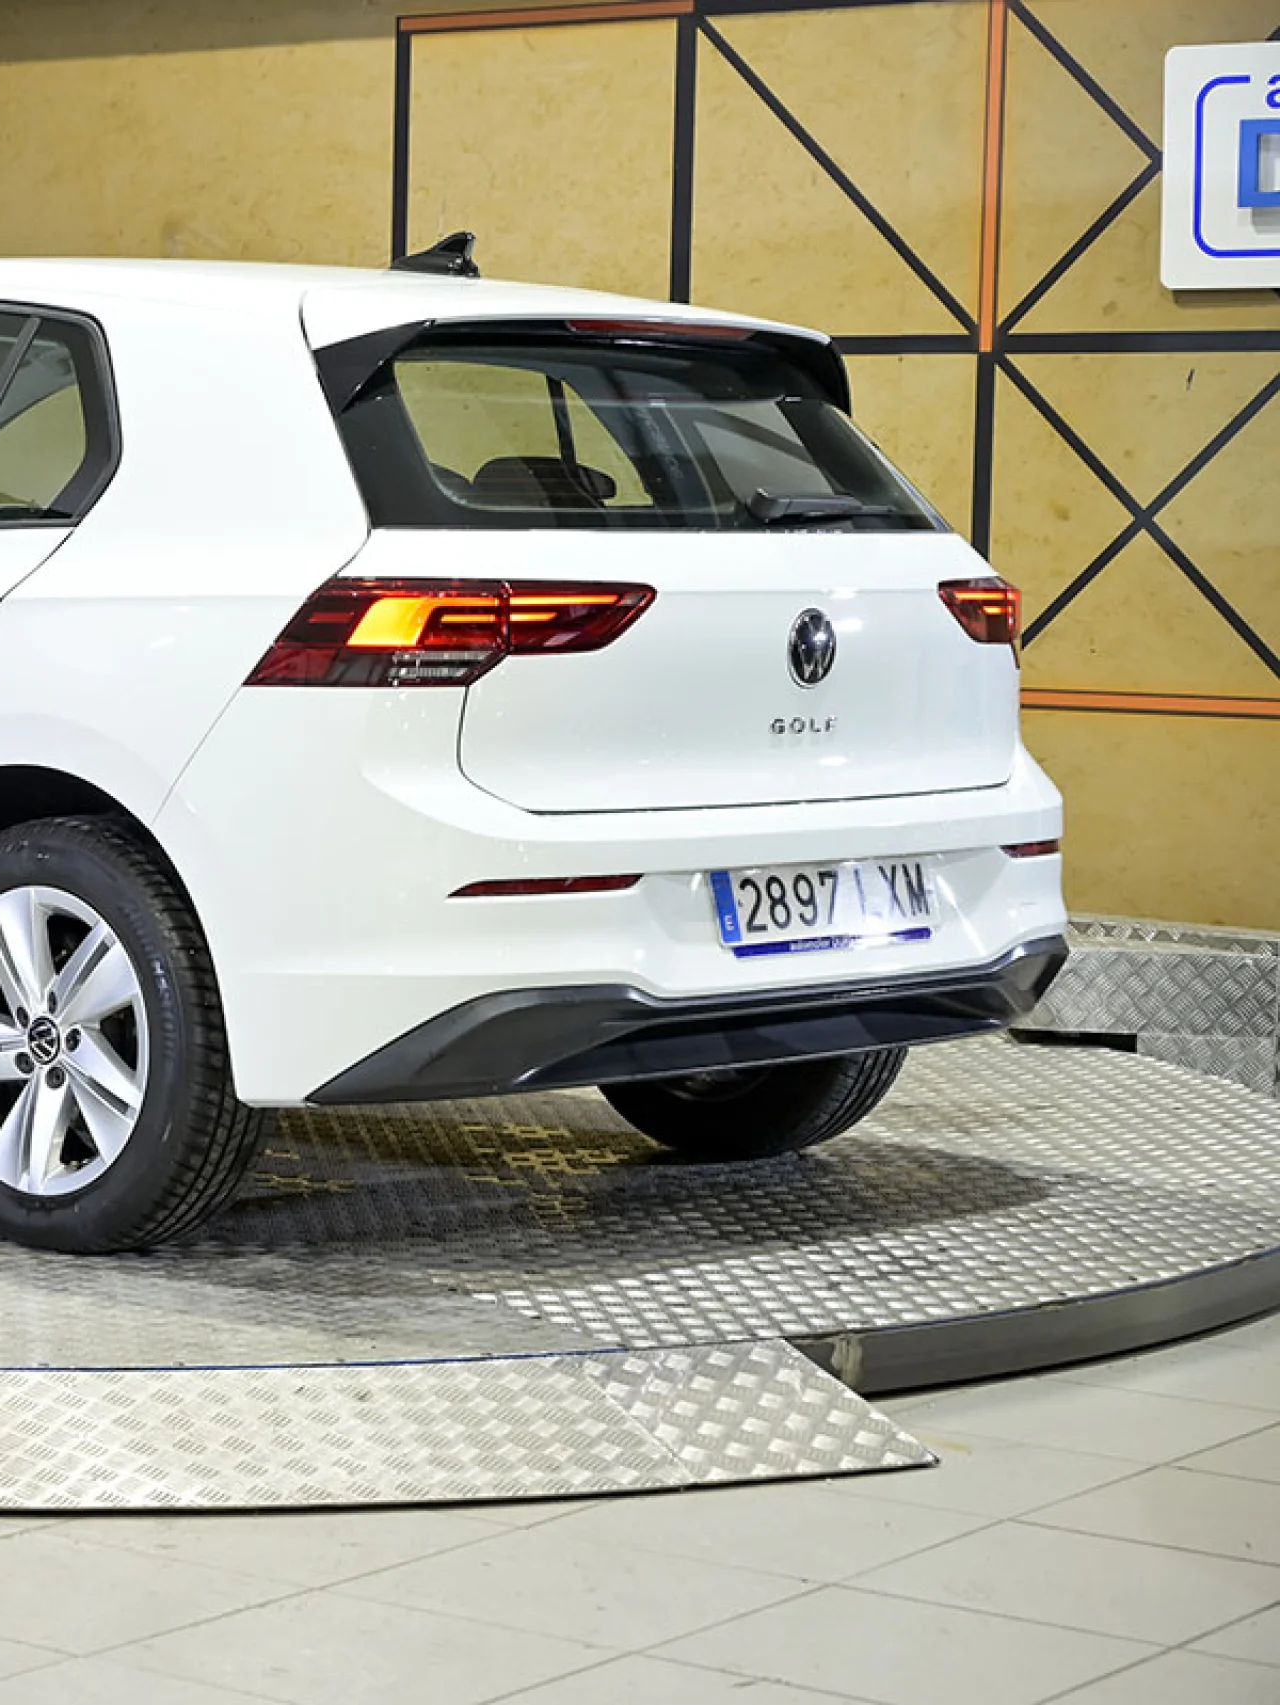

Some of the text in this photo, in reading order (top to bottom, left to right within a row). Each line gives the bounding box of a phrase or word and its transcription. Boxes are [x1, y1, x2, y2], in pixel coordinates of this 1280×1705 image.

[769, 716, 837, 734] GOLF
[738, 870, 838, 933] 2897
[724, 914, 735, 931] E
